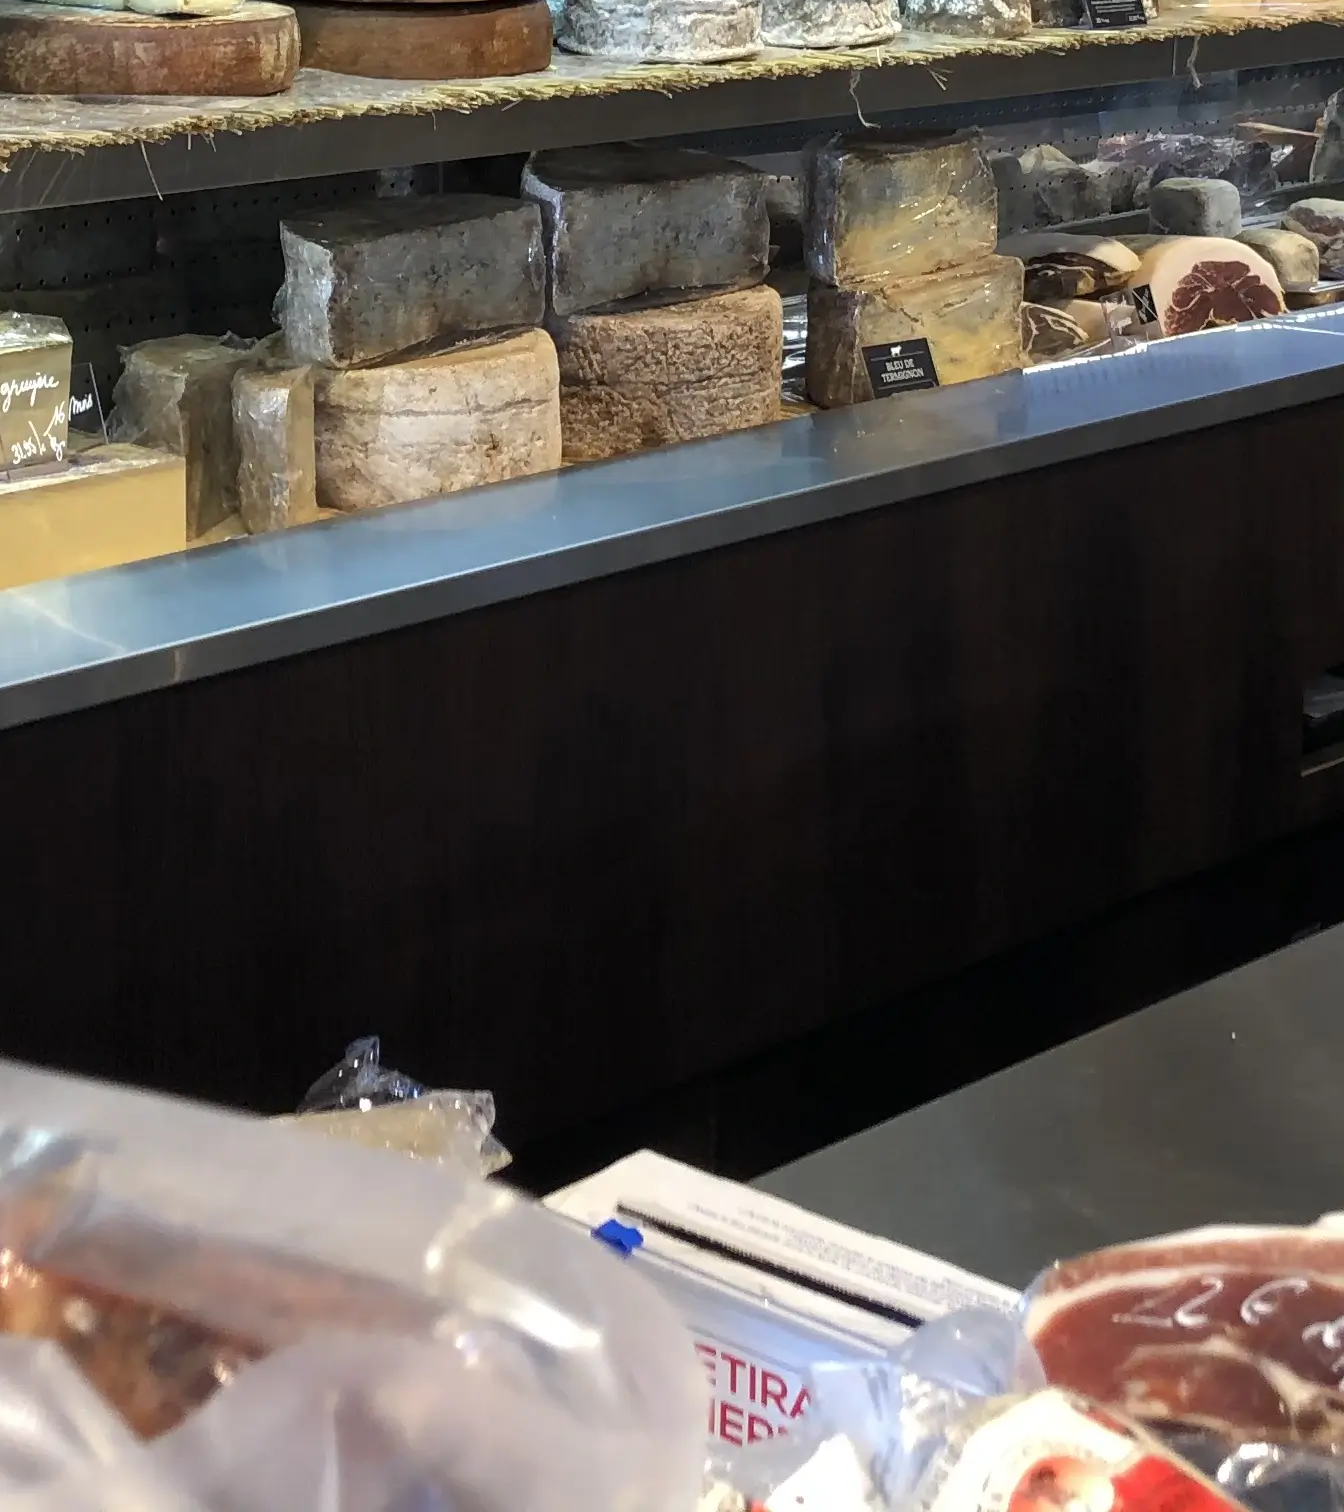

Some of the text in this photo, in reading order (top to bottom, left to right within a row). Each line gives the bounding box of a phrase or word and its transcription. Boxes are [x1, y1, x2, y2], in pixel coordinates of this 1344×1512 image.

[885, 358, 915, 371] BLEU DE
[881, 368, 924, 382] TERMIGNON
